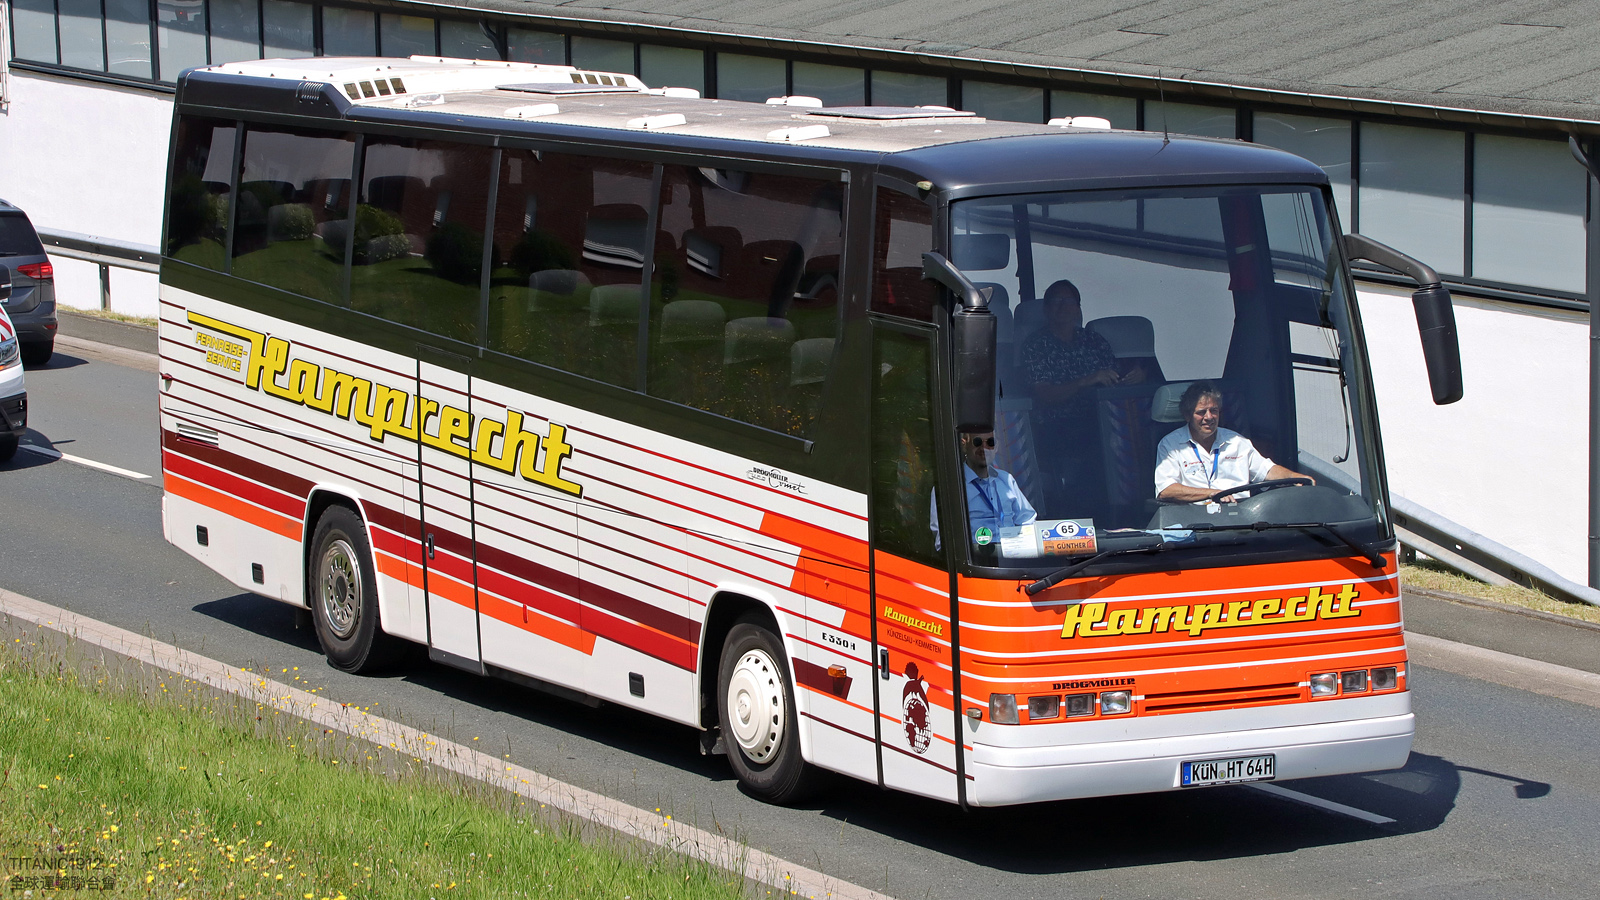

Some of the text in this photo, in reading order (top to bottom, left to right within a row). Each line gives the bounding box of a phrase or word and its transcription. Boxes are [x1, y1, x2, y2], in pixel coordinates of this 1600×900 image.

[195, 331, 248, 358] FERNREISE-
[206, 350, 241, 373] SERVICE
[187, 310, 583, 498] Hamprecht
[1061, 525, 1074, 534] 65
[1056, 541, 1086, 550] GÜNTHER
[883, 605, 943, 637] Hamprecht
[1060, 583, 1361, 639] Hamprecht
[1052, 677, 1136, 690] DRÖGMÖLLER
[1192, 757, 1273, 781] KÜN HT 64H
